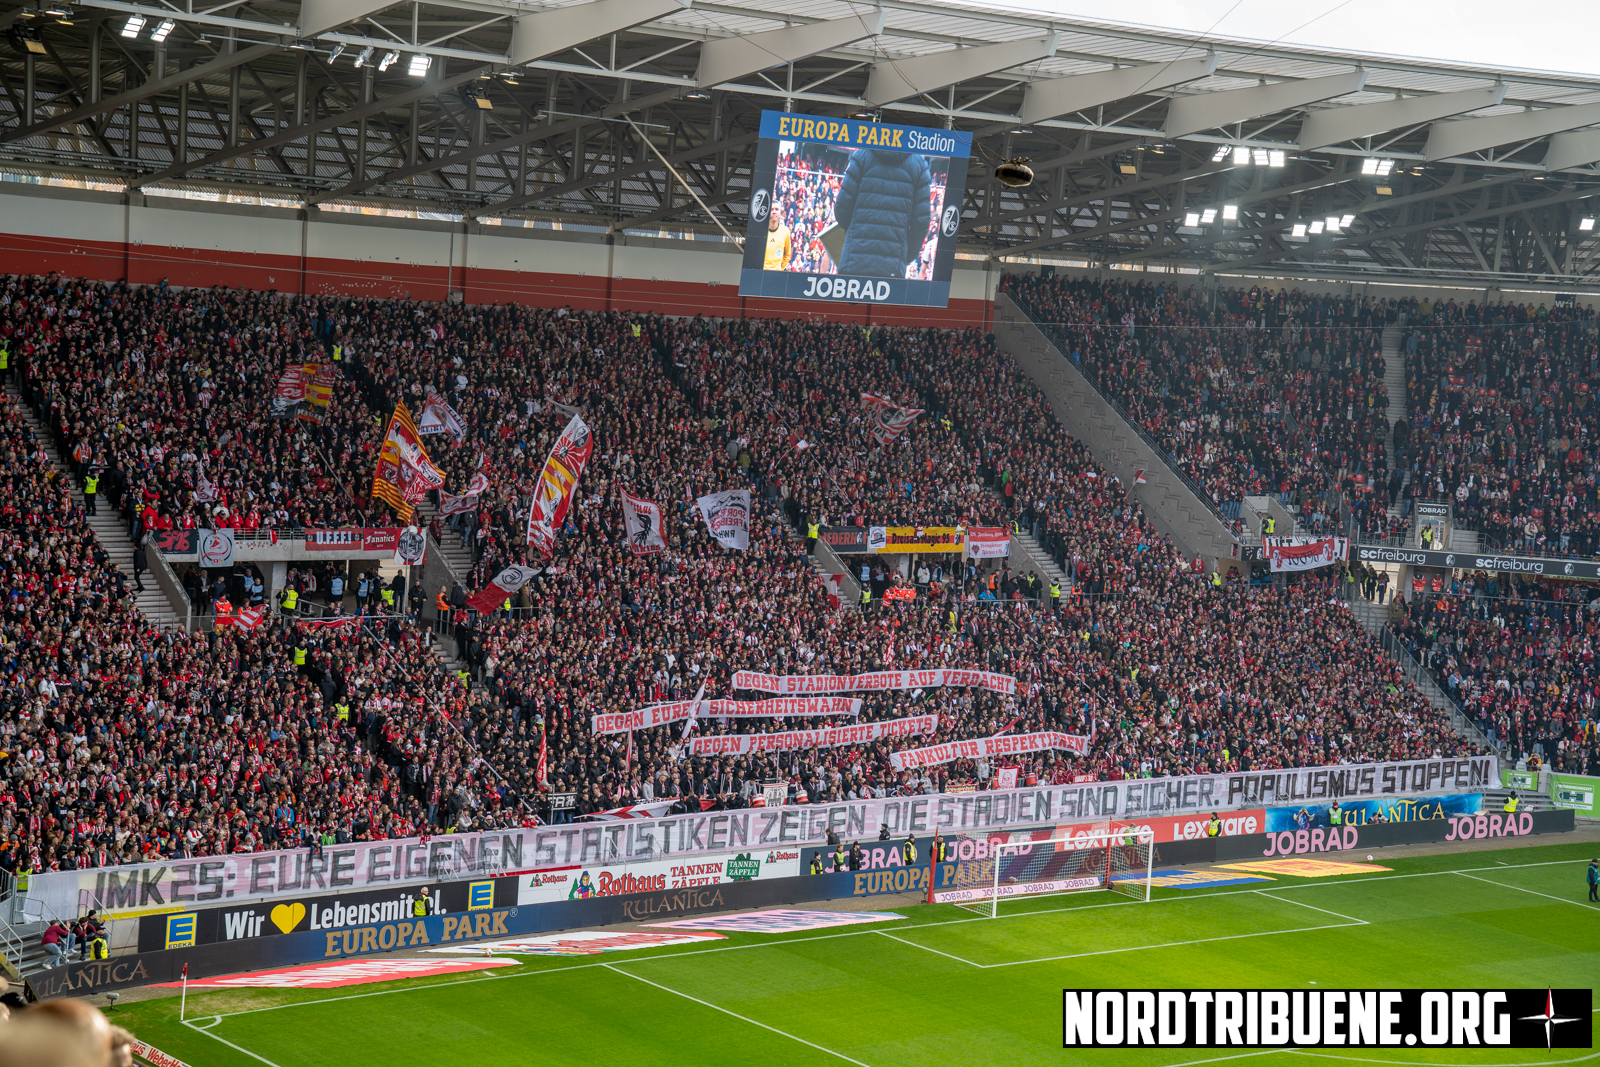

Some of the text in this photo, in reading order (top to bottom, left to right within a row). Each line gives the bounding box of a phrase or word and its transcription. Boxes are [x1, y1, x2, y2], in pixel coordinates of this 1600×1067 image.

[778, 116, 955, 152] EUROPA PARK Stadion
[803, 276, 890, 300] JOBRAD
[1418, 506, 1447, 515] JOBRAD
[736, 671, 1012, 692] GEGEN STADIONVERBOTE AUF VERDACHT
[599, 713, 644, 732] GEGEN
[709, 698, 853, 715] SICHERHEITSWAHN
[693, 717, 932, 754] GEGEN PERSONALISIERTE TICKETS
[900, 732, 1085, 767] FANKULTUR RESPEKTIEREN
[94, 866, 167, 910] IMK
[170, 861, 236, 903] 25:
[250, 849, 355, 895] EURE
[368, 833, 523, 884] EIGENEN
[535, 813, 749, 866] STATISTIKEN
[759, 805, 867, 845] ZEIGEN
[883, 799, 928, 835] DIE
[937, 790, 1051, 829] STADIEN
[1060, 787, 1118, 818] SIND
[1228, 767, 1376, 805] POPULISMUS
[1382, 759, 1491, 792] STOPPEN!
[1445, 813, 1534, 841] JOBRAD
[1263, 827, 1358, 857] JOBRAD
[727, 860, 760, 869] TANNEN
[776, 850, 799, 861] Rothaus
[541, 873, 568, 884] Rothaus
[670, 863, 724, 878] TANNEN
[728, 867, 757, 877] ZÄPFLE
[853, 860, 995, 895] EUROPA PARK
[597, 871, 666, 897] Rothaus
[982, 887, 1014, 897] JORAD
[1023, 883, 1055, 893] JOBRAD
[1063, 878, 1095, 889] JOBRAD
[622, 887, 726, 921] RULANTICA
[941, 891, 973, 902] JOBRAD
[224, 910, 265, 941] Wir
[324, 920, 429, 957] EUROPA
